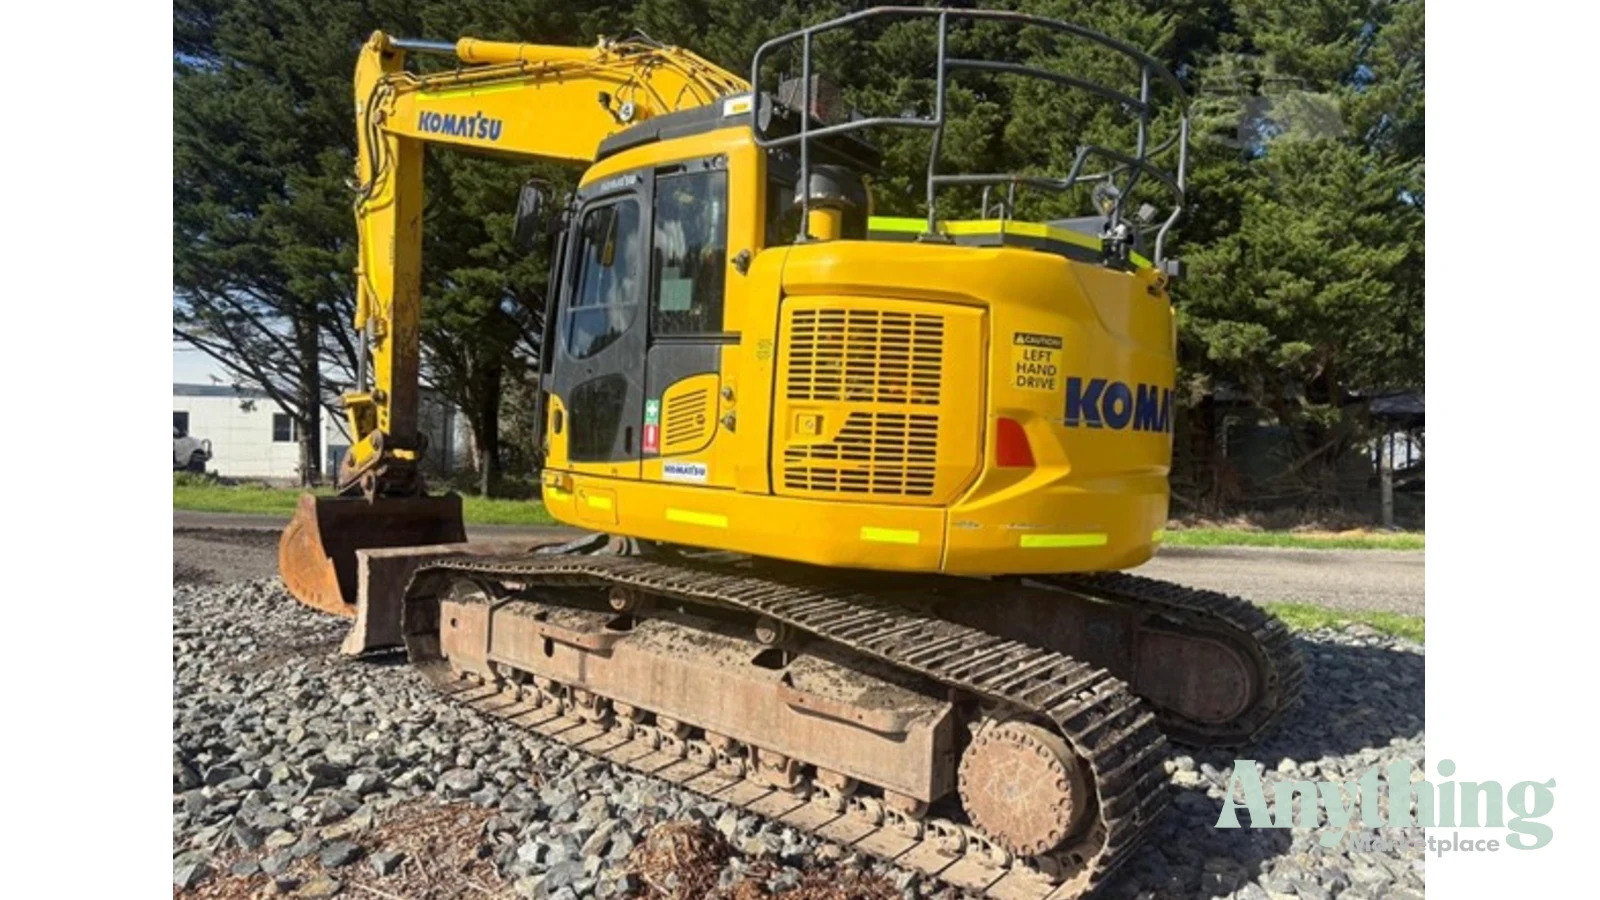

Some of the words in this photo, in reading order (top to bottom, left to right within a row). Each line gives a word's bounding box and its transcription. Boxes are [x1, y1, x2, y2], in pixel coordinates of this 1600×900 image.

[418, 110, 502, 141] KOMATSU
[1023, 349, 1051, 362] LEFT
[1016, 362, 1057, 376] HAND
[1016, 375, 1055, 390] DRIVE
